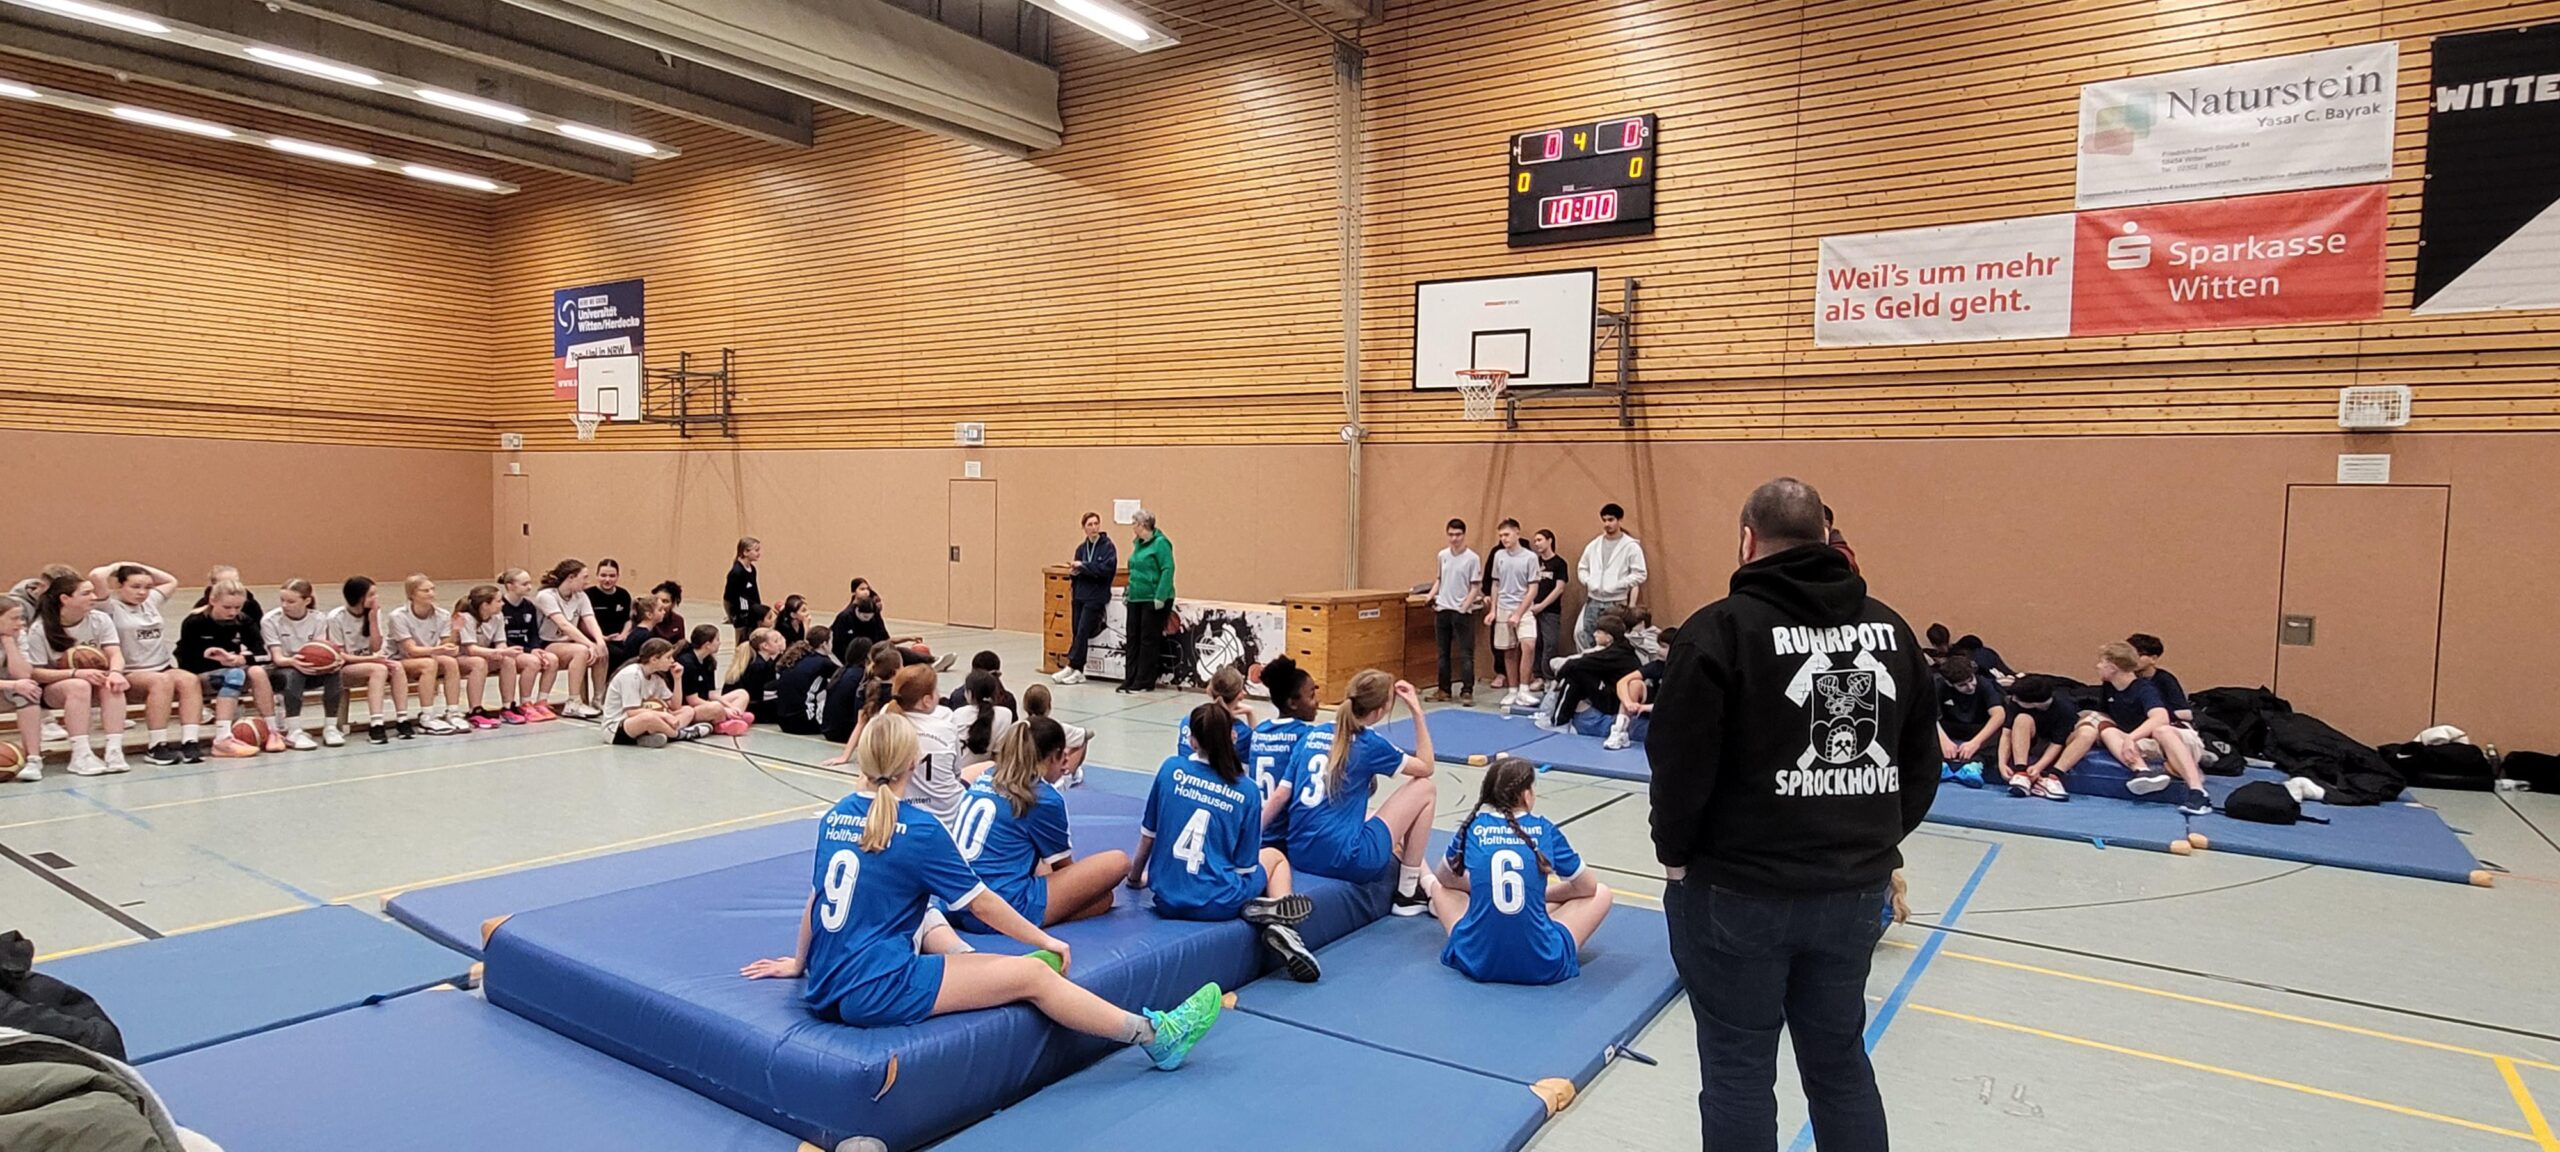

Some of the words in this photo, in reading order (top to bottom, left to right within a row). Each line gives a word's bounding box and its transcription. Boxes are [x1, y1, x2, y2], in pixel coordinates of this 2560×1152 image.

[2166, 65, 2382, 119] Naturstein
[2436, 73, 2560, 113] WITTE
[2256, 114, 2300, 128] Yasar
[2304, 110, 2320, 123] C.
[2325, 103, 2381, 121] Bayrak
[1545, 133, 1560, 159] 0
[1573, 132, 1587, 151] 4
[1623, 121, 1640, 147] 0
[1517, 172, 1531, 193] 0
[1629, 157, 1643, 178] 0
[1549, 193, 1614, 224] 10:00
[2168, 233, 2346, 270] Sparkasse
[1828, 264, 1909, 291] Weil's
[1919, 264, 1966, 285] um
[1976, 251, 2061, 281] mehr
[2168, 275, 2279, 302] Witten
[578, 306, 618, 320] Universität
[1825, 298, 1866, 322] als
[1875, 292, 1940, 320] Geld
[1950, 287, 2031, 322] geht.
[1772, 622, 1898, 655] RUHRPOTT
[920, 753, 932, 781] 1
[1256, 756, 1276, 809] 5
[1300, 754, 1329, 808] 3
[1172, 769, 1245, 804] Gymnasium
[1174, 784, 1234, 813] Holthausen
[1173, 808, 1211, 875] 4
[821, 849, 860, 932] 9
[1491, 849, 1526, 915] 6
